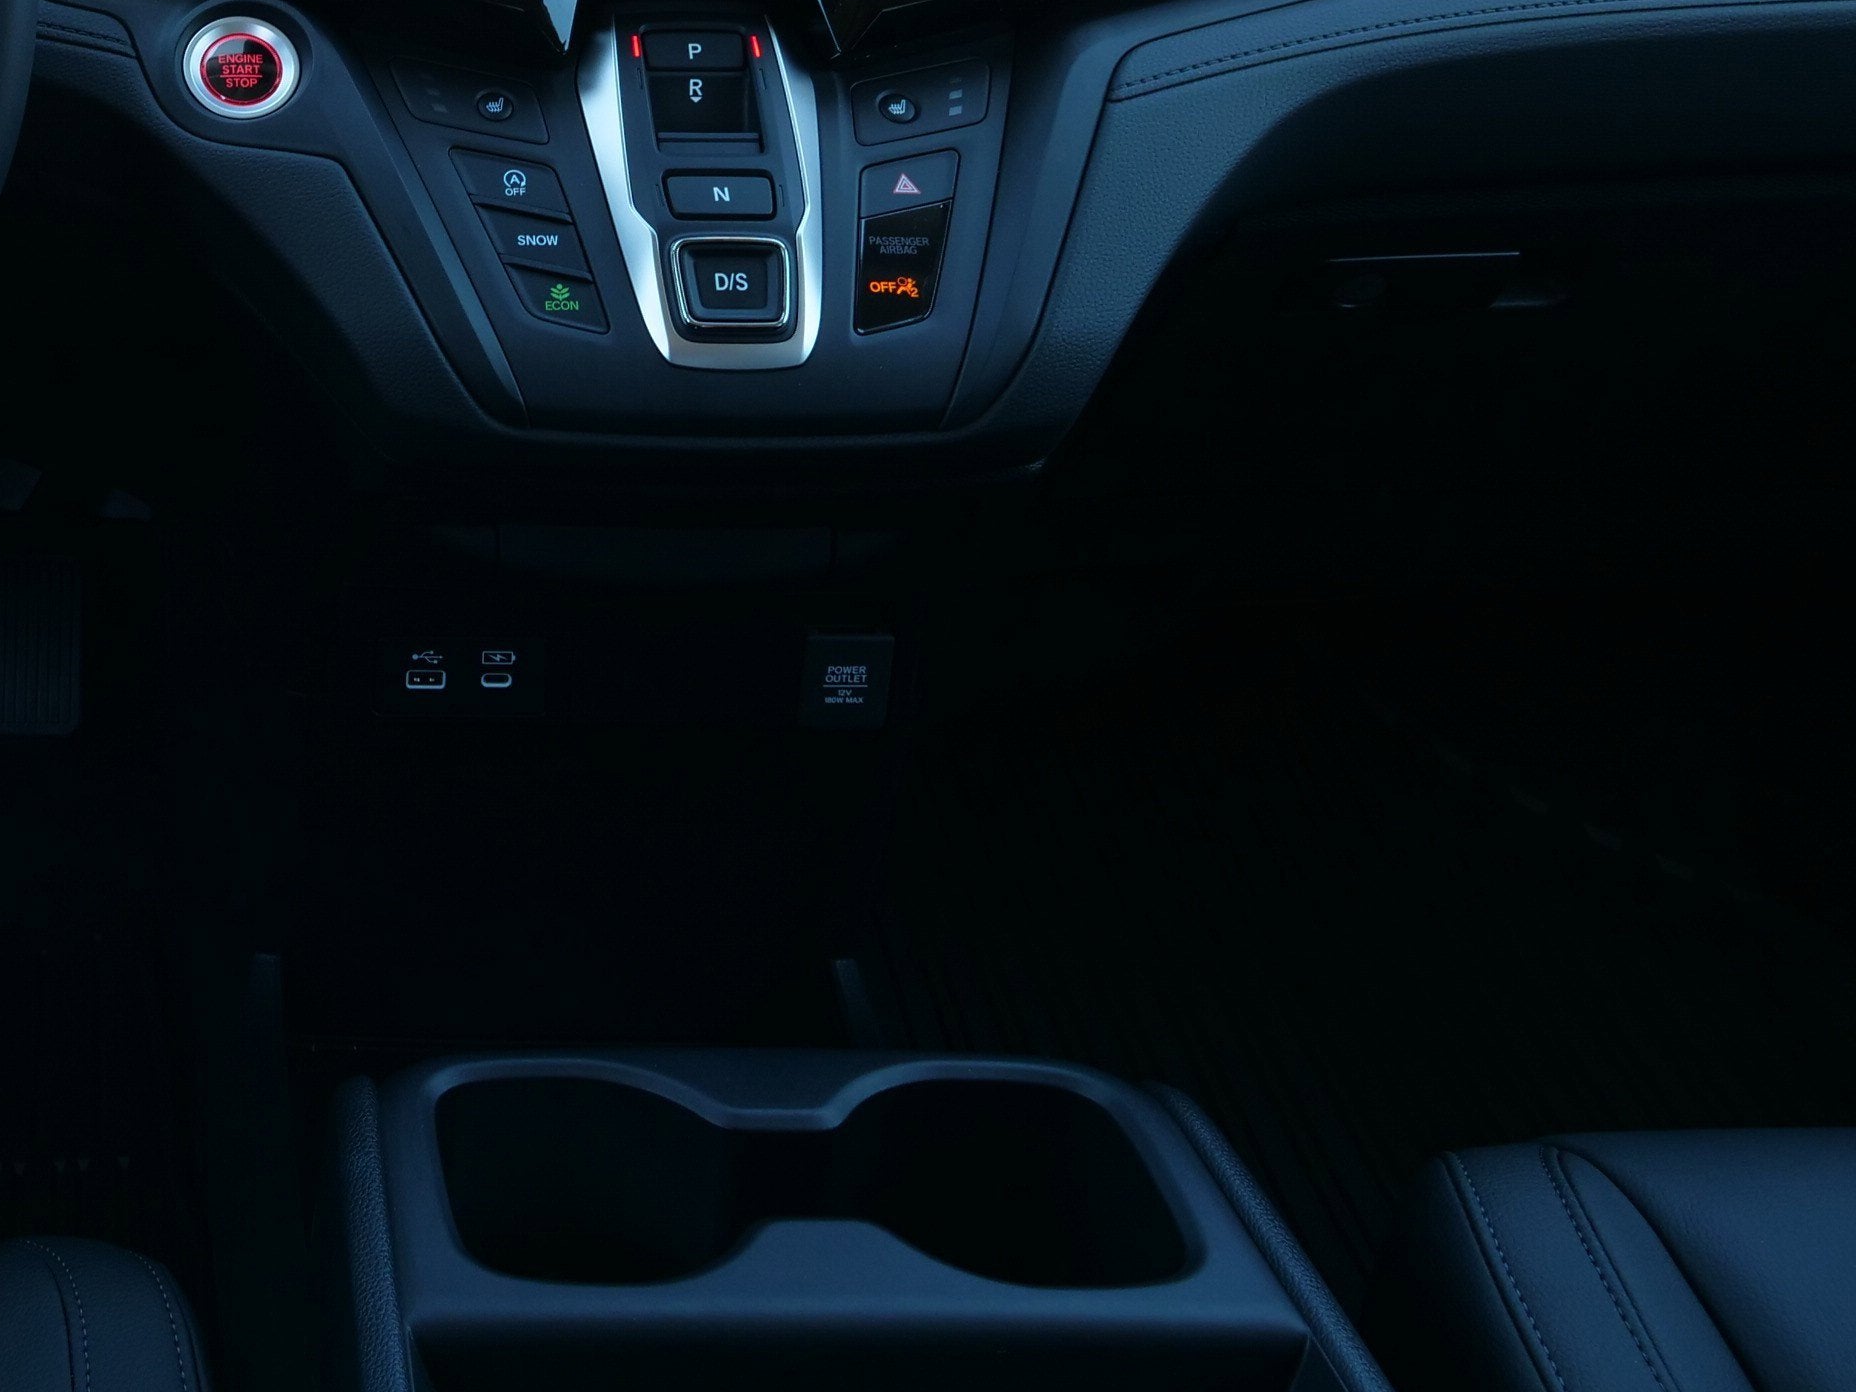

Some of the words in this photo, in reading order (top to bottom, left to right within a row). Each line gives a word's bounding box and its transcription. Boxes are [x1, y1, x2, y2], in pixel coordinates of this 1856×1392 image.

[688, 43, 702, 59] P
[218, 54, 263, 64] ENGINE
[222, 64, 260, 75] START
[225, 77, 257, 89] STOP
[689, 80, 702, 96] R
[504, 187, 526, 197] OFF
[713, 187, 730, 202] N
[517, 234, 558, 247] SNOW
[868, 235, 929, 247] PASSENGER
[879, 244, 918, 255] AIRBAG
[714, 272, 748, 292] D/S
[869, 280, 896, 293] OFF
[545, 301, 579, 312] ECON
[827, 665, 866, 674] POWER
[825, 674, 867, 683] OUTLET
[845, 696, 864, 704] MAX
